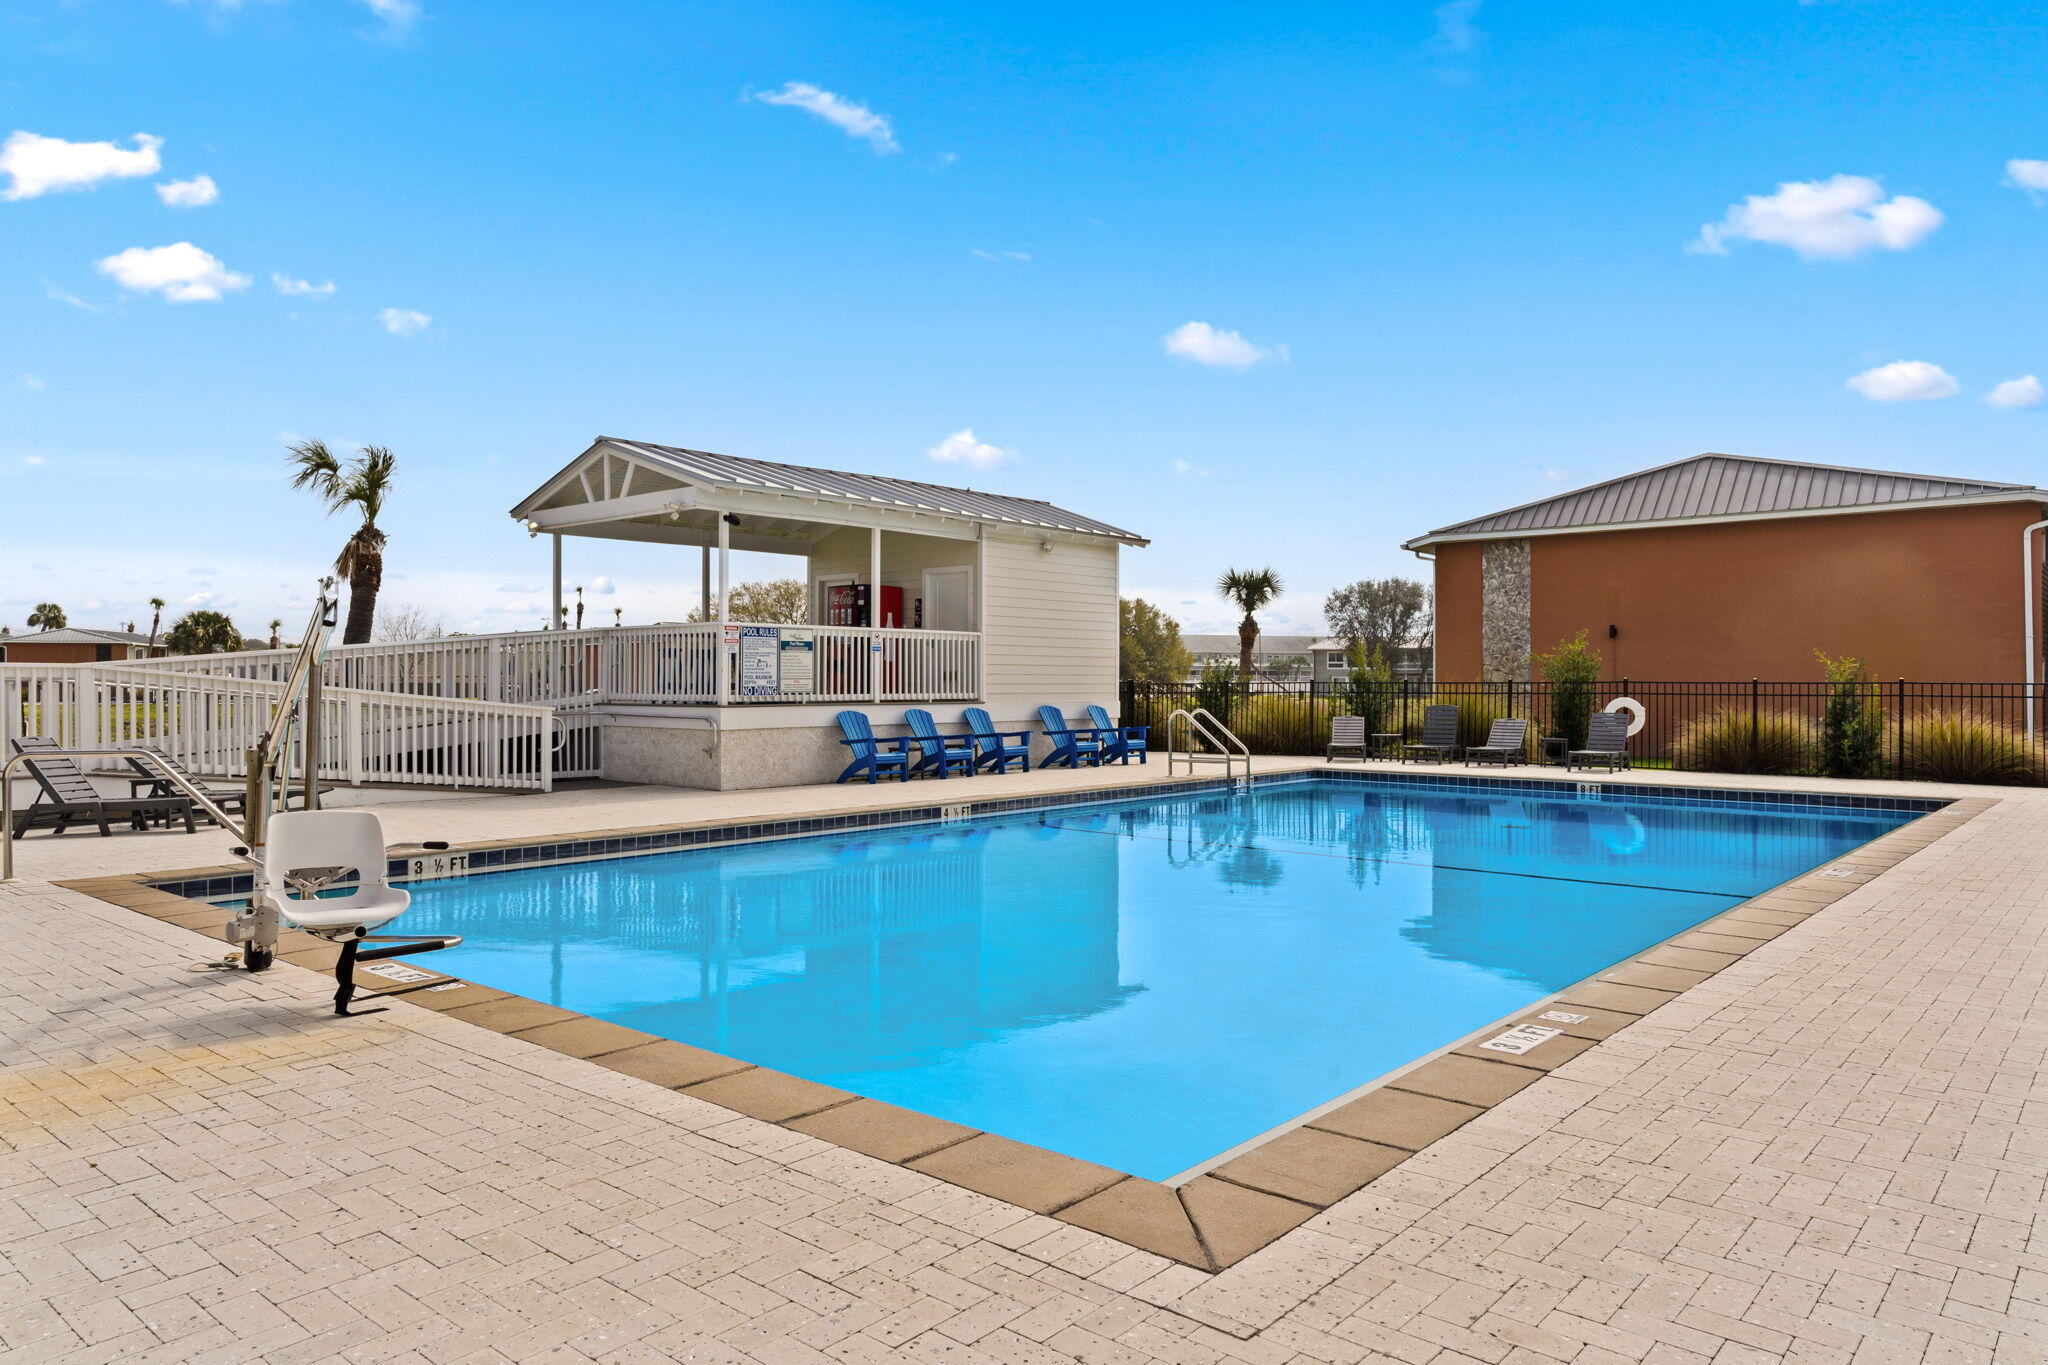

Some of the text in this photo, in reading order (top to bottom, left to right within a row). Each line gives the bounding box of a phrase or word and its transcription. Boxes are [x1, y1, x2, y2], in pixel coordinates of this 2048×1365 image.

[743, 628, 757, 637] POOL
[759, 628, 778, 637] RULES
[743, 686, 753, 696] NO
[755, 686, 778, 696] DIVING
[1580, 784, 1586, 794] 8
[943, 807, 949, 818] 4
[414, 860, 423, 875] 3
